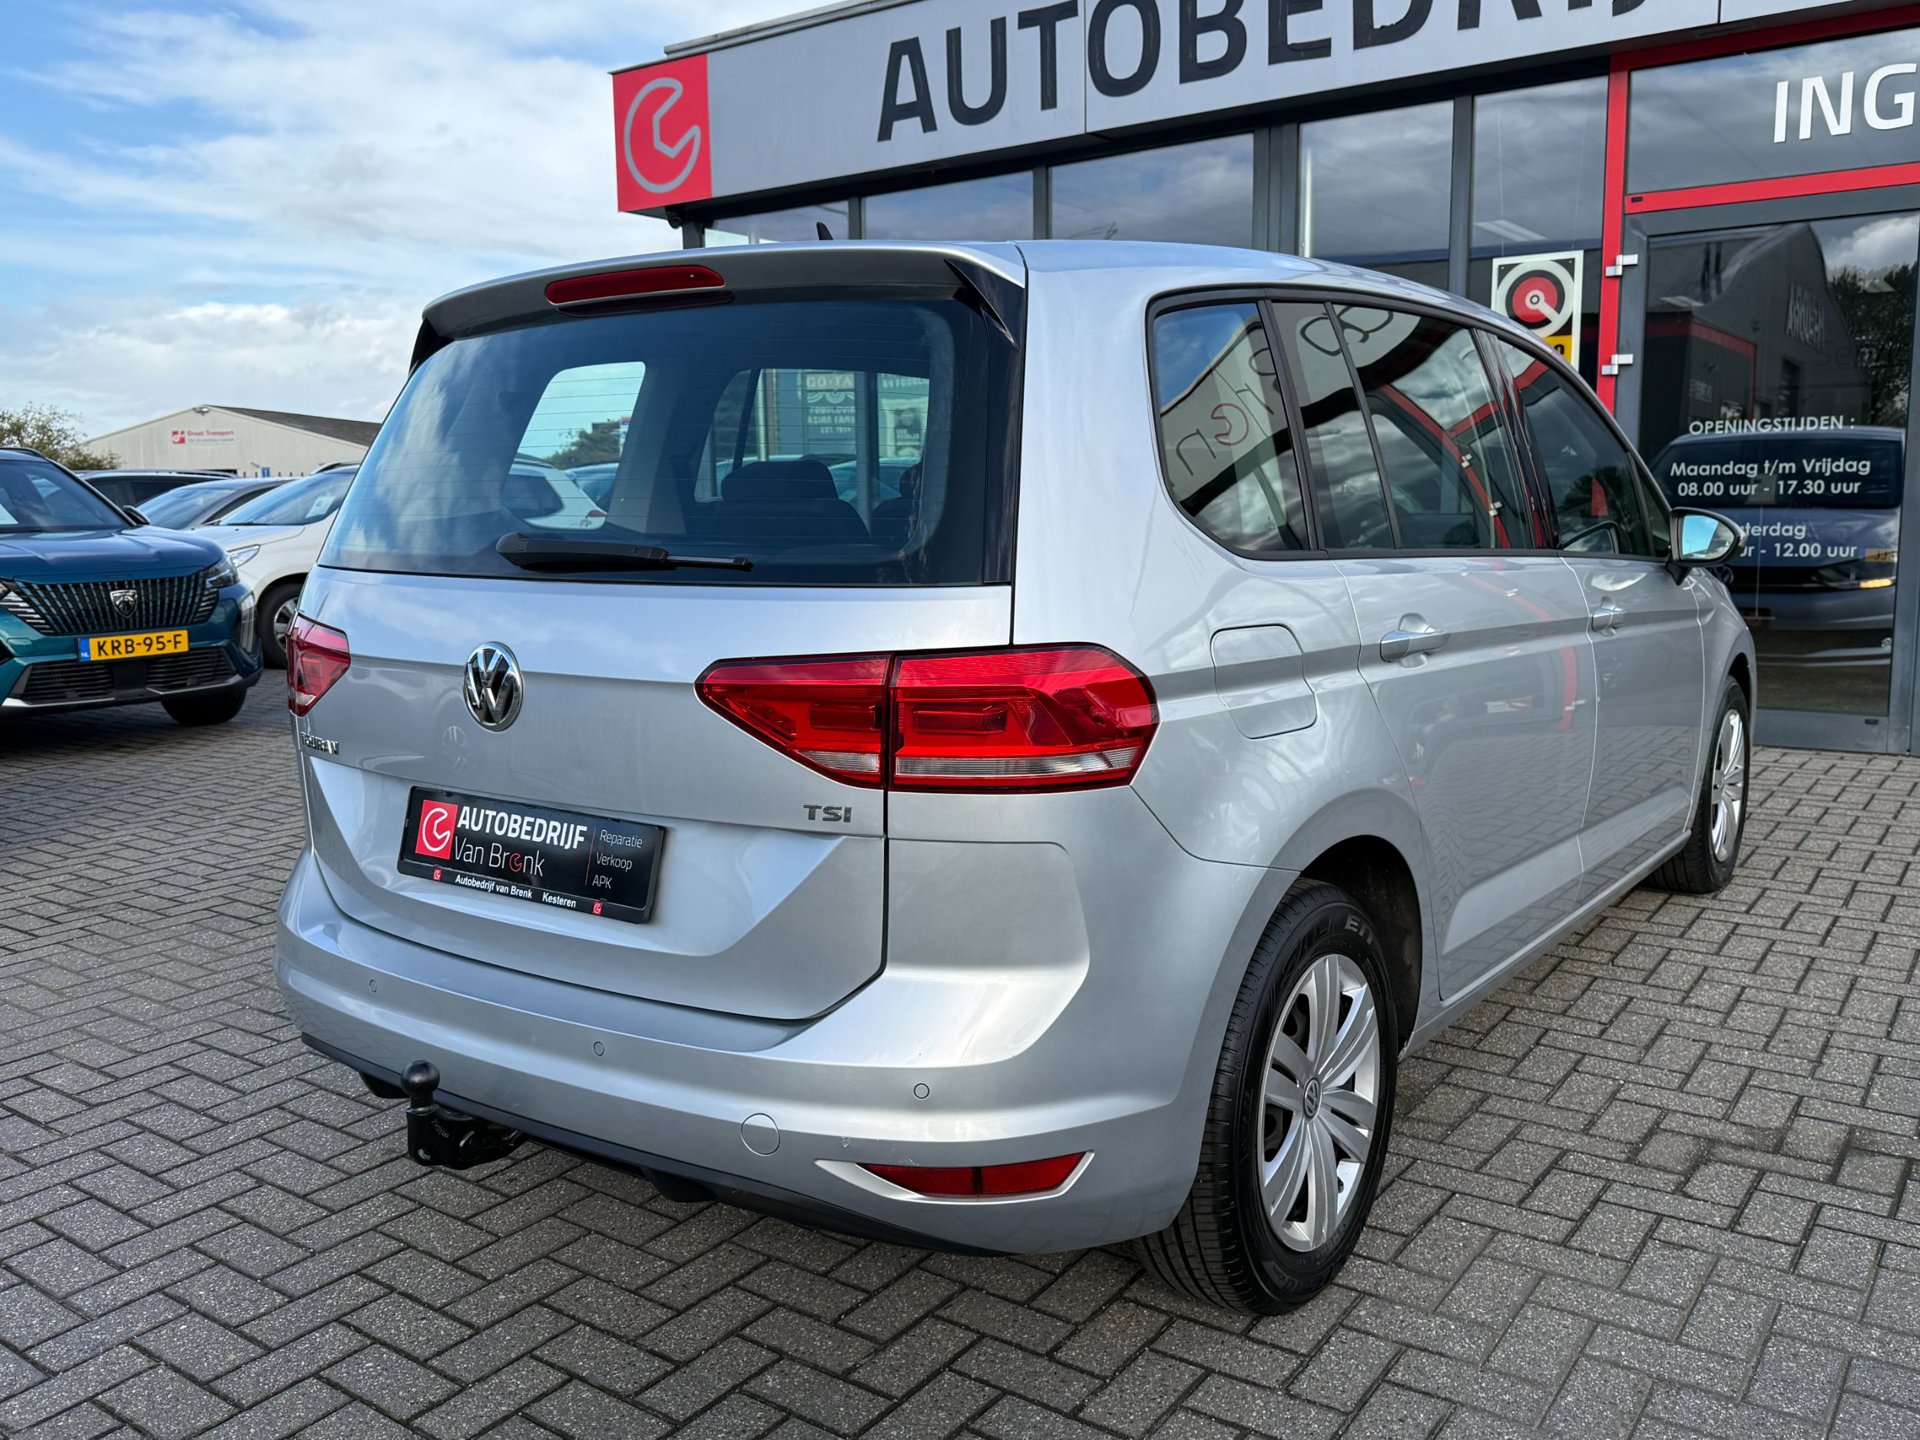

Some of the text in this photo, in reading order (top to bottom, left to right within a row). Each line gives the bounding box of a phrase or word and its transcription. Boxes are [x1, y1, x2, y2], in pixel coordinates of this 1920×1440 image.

[876, 0, 1650, 142] AUTOBE
[1773, 63, 1918, 144] ING
[1688, 415, 1844, 436] OPENINGSTIJDEN
[1669, 457, 1871, 477] Maandag t/m Vrijdag
[1677, 481, 1725, 496] 08.00
[1729, 483, 1758, 496] uur
[1776, 480, 1826, 495] 17.30
[1830, 480, 1862, 494] uur
[1741, 521, 1806, 540] terdag
[1773, 542, 1822, 558] 12.00
[1826, 544, 1858, 558] uur
[97, 634, 183, 657] KRB-95-F
[802, 804, 853, 823] TSI
[456, 805, 588, 850] AUTOBEDRIJF
[599, 829, 643, 849] Reparatie
[454, 836, 485, 865] Van
[595, 851, 633, 872] Verkoop
[454, 874, 577, 908] Autobedrijf van Brenk Kesteren
[591, 874, 613, 890] APK
